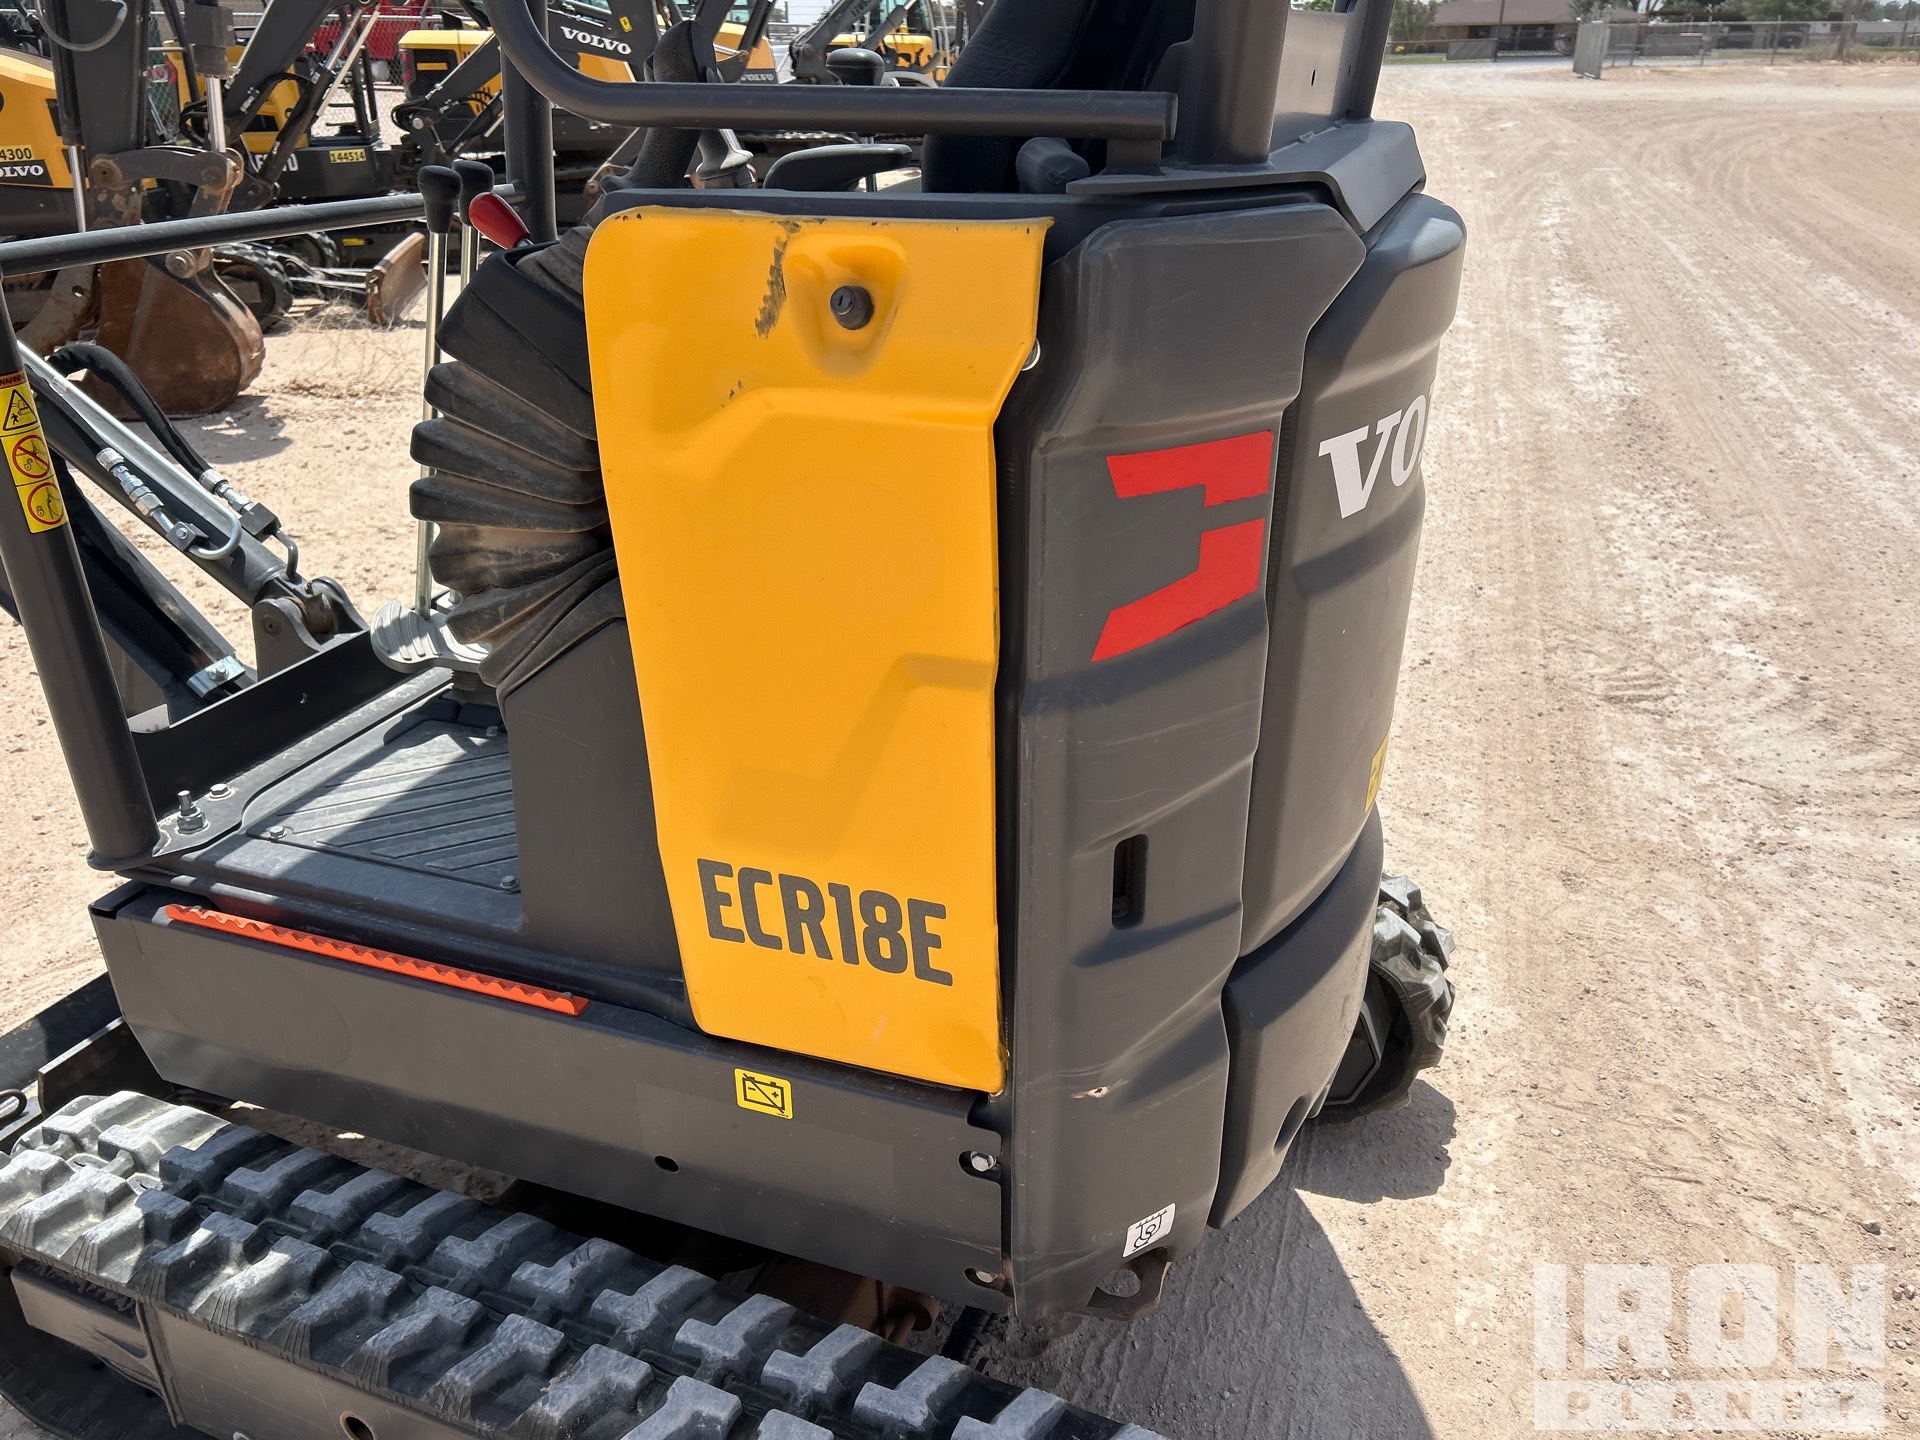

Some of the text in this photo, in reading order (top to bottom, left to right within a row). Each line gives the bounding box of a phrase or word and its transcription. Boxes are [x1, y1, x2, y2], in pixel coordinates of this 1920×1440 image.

[560, 26, 632, 55] VOLVO
[331, 151, 365, 162] 144514
[0, 164, 44, 178] LVO
[696, 858, 953, 987] ECR18E
